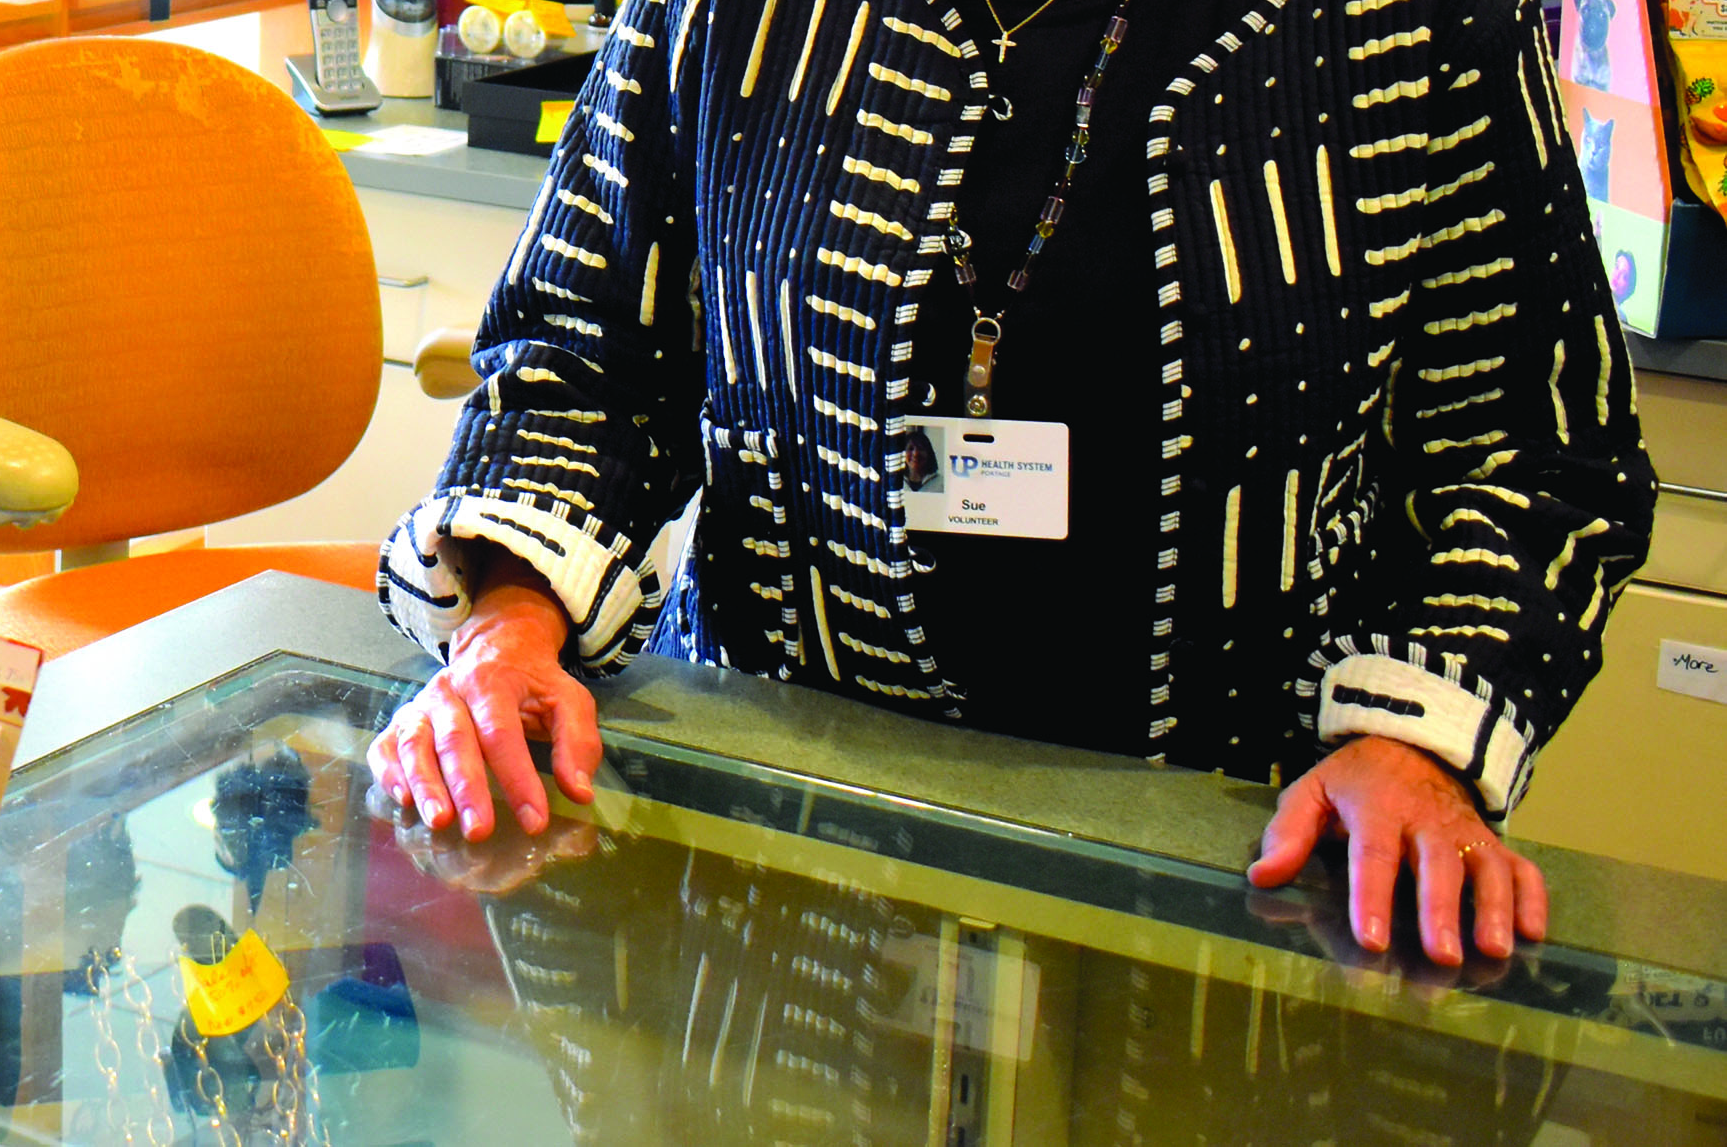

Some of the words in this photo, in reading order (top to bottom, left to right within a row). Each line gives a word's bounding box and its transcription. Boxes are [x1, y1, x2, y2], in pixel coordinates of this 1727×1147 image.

[949, 454, 979, 478] UP
[981, 460, 1015, 470] HEALTH
[1017, 462, 1053, 472] SYSTEM
[961, 499, 986, 511] Sue
[948, 515, 999, 526] VOLUNTEER
